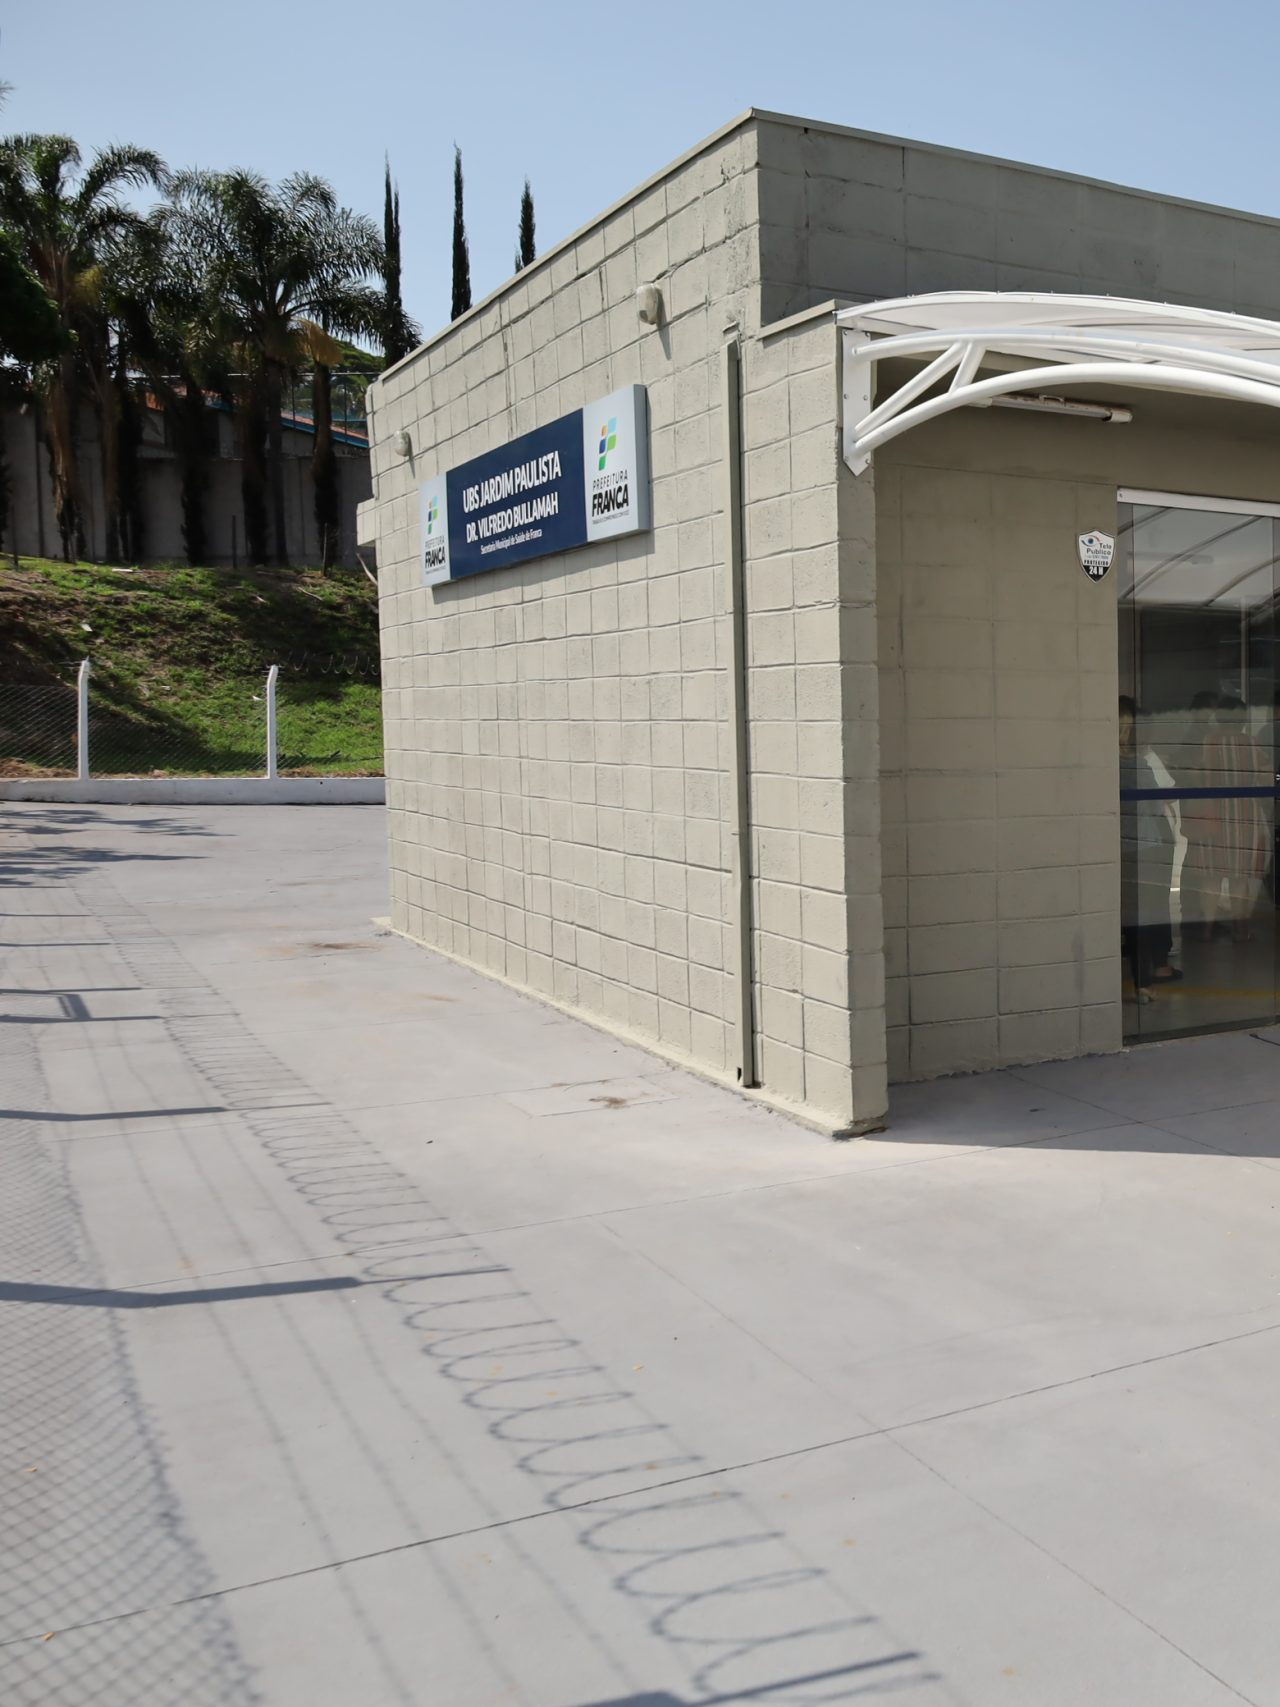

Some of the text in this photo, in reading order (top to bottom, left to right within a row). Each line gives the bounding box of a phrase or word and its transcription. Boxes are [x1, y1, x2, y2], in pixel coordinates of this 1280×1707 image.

[463, 450, 562, 513] UBS JARDIM PAULISTA
[593, 469, 628, 493] PREFEITURA
[592, 484, 629, 517] FRANCA
[466, 522, 479, 543] DR.
[478, 508, 513, 539] VILFREDO
[513, 491, 558, 527] BULLAMAH
[495, 535, 511, 549] Municipal
[425, 545, 446, 568] FRANCA
[1089, 566, 1098, 575] 24
